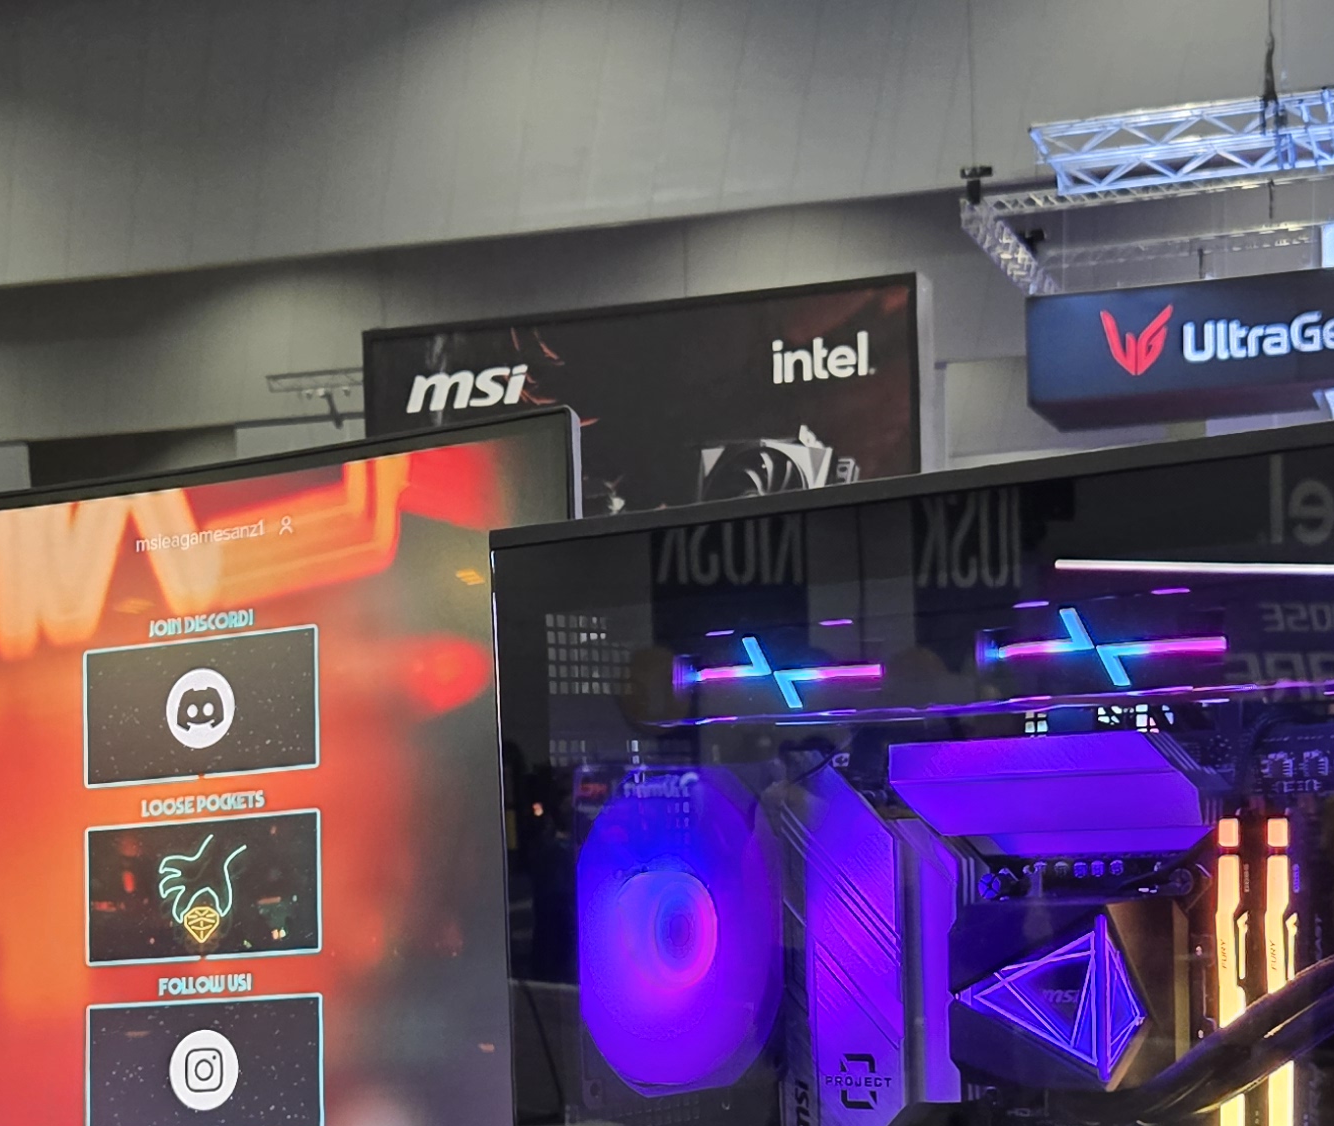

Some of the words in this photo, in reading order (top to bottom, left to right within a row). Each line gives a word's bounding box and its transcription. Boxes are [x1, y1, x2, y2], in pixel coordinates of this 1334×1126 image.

[406, 365, 528, 413] msi
[149, 618, 183, 637] JOIN
[184, 609, 254, 632] DISCORD!
[141, 796, 195, 817] LOOSE
[196, 790, 266, 812] POCKETS
[158, 975, 224, 996] FOLLOW
[227, 973, 252, 990] US!
[826, 1075, 892, 1087] PROJECT
